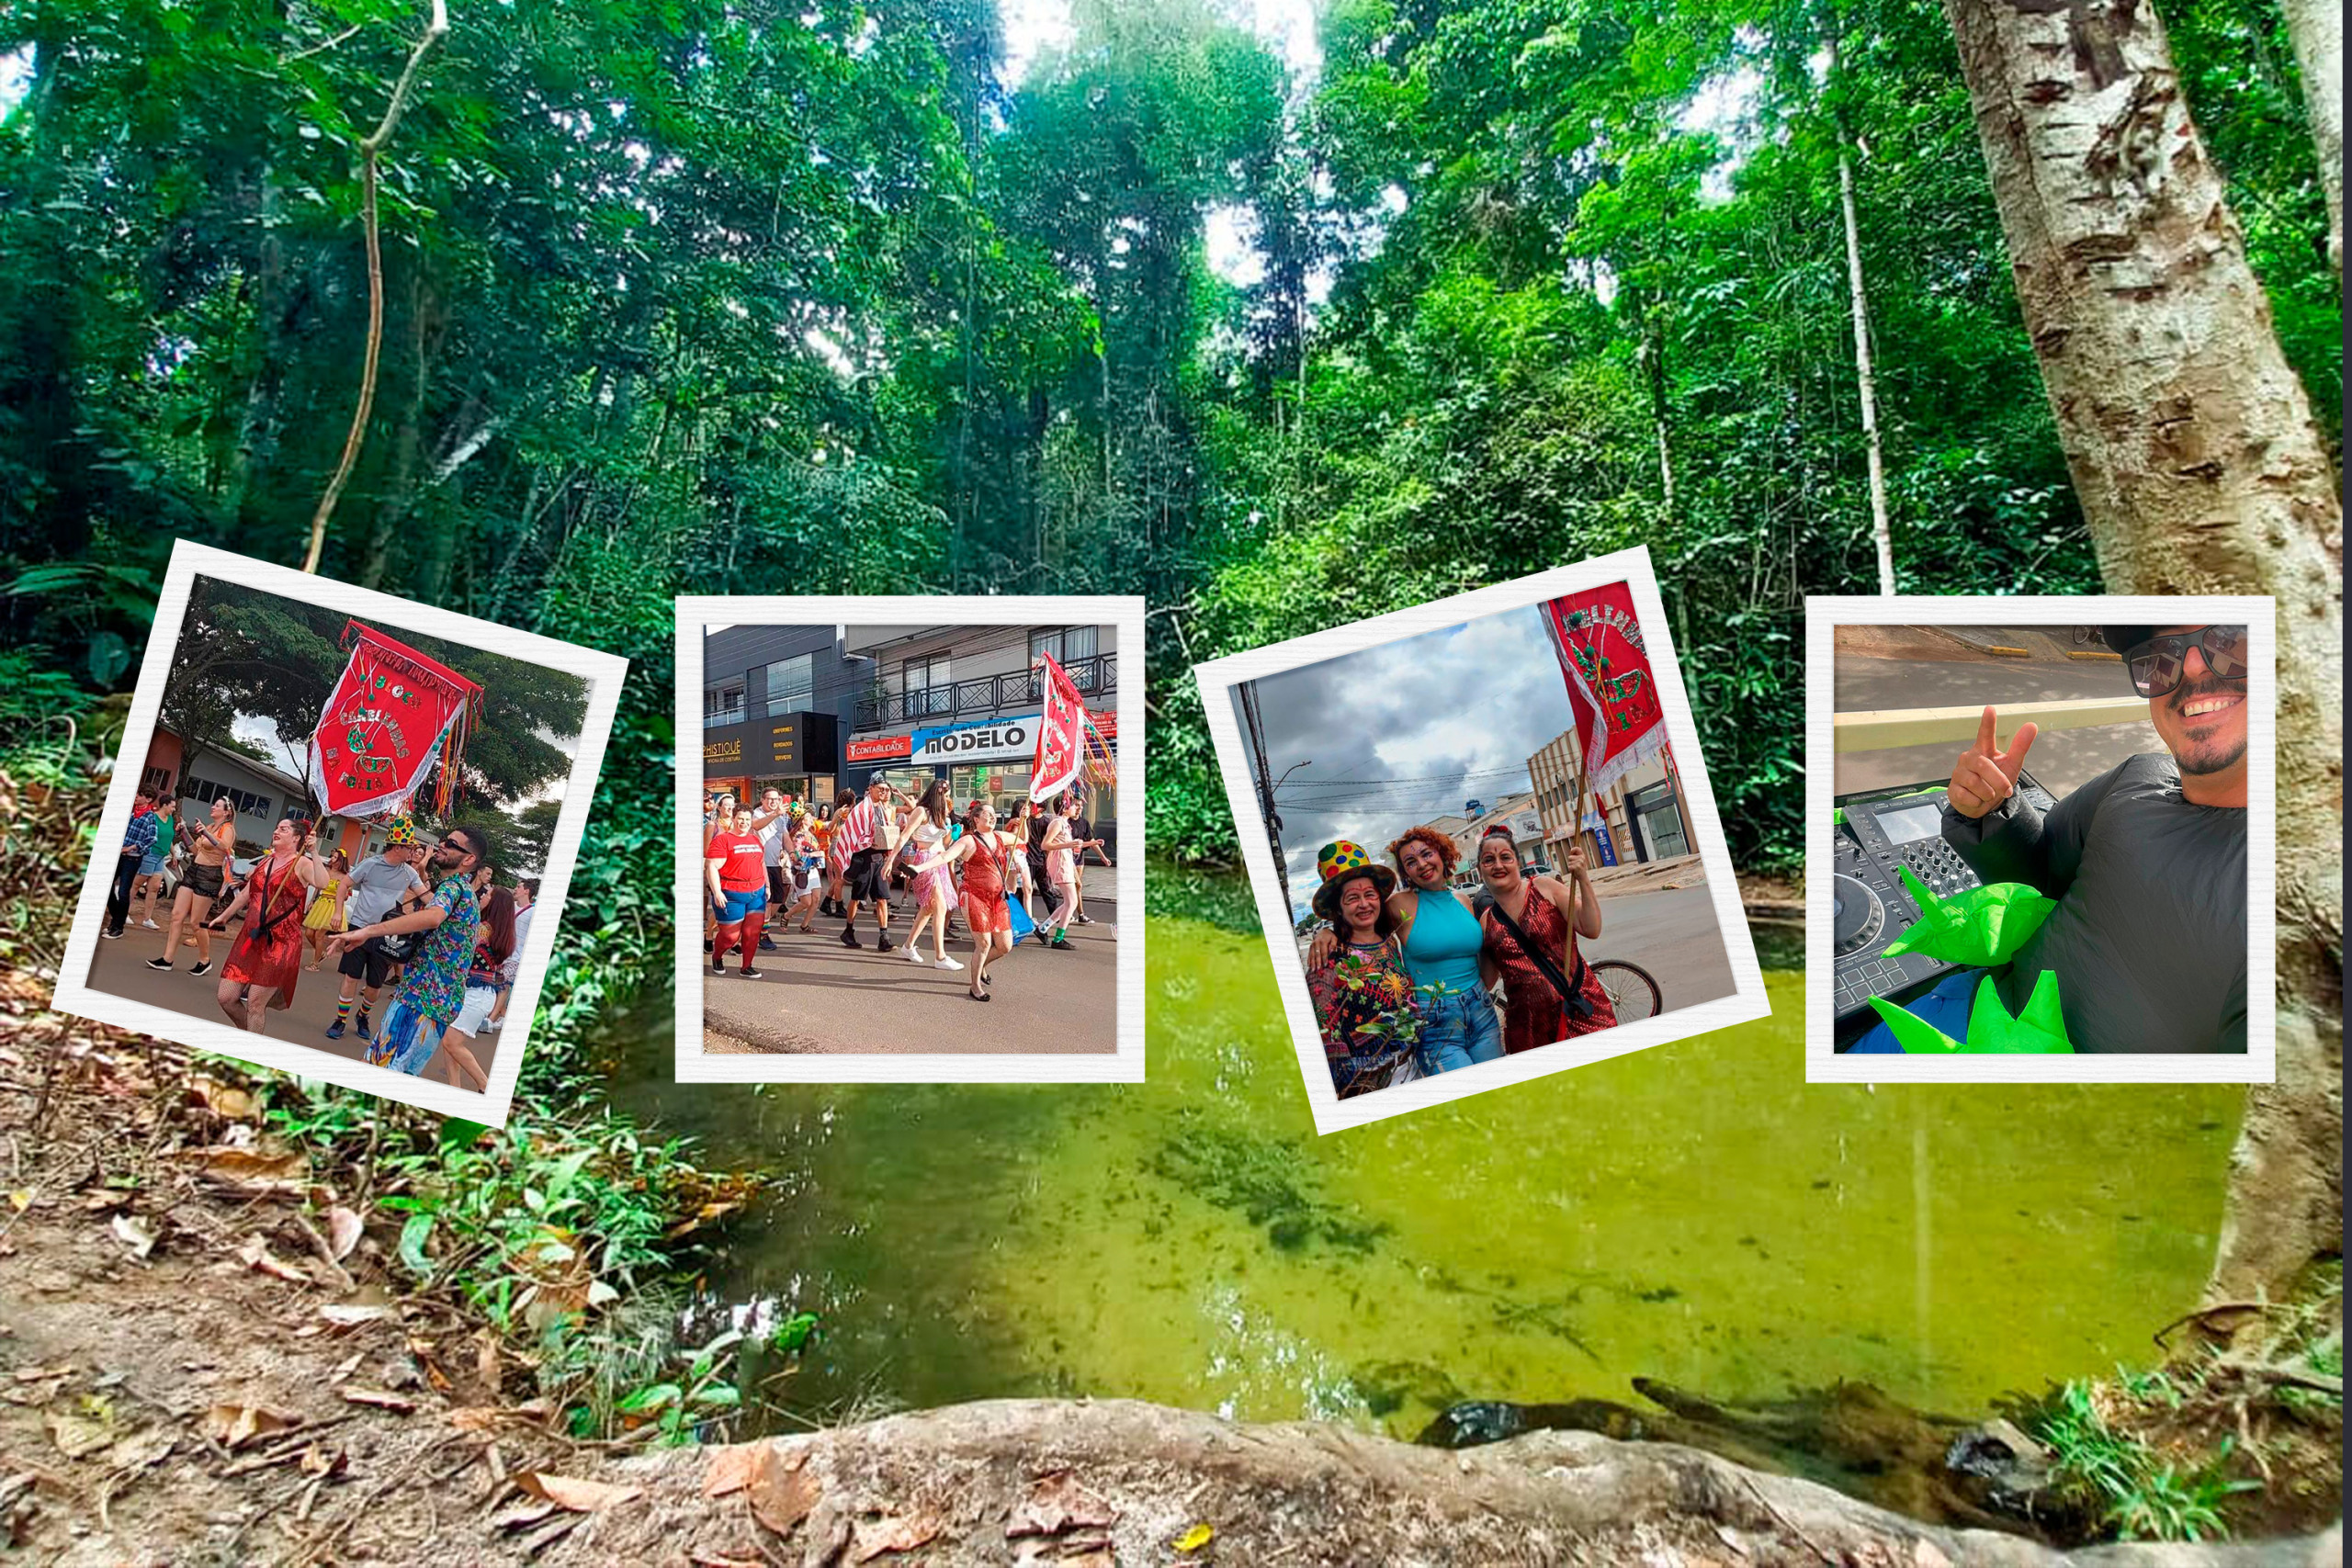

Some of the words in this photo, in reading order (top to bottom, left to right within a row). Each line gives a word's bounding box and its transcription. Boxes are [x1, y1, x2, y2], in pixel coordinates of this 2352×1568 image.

[375, 675, 422, 710] BLOCO
[855, 742, 904, 755] CONTABILIDADE
[925, 727, 1026, 754] MODELO
[379, 944, 400, 957] adidas
